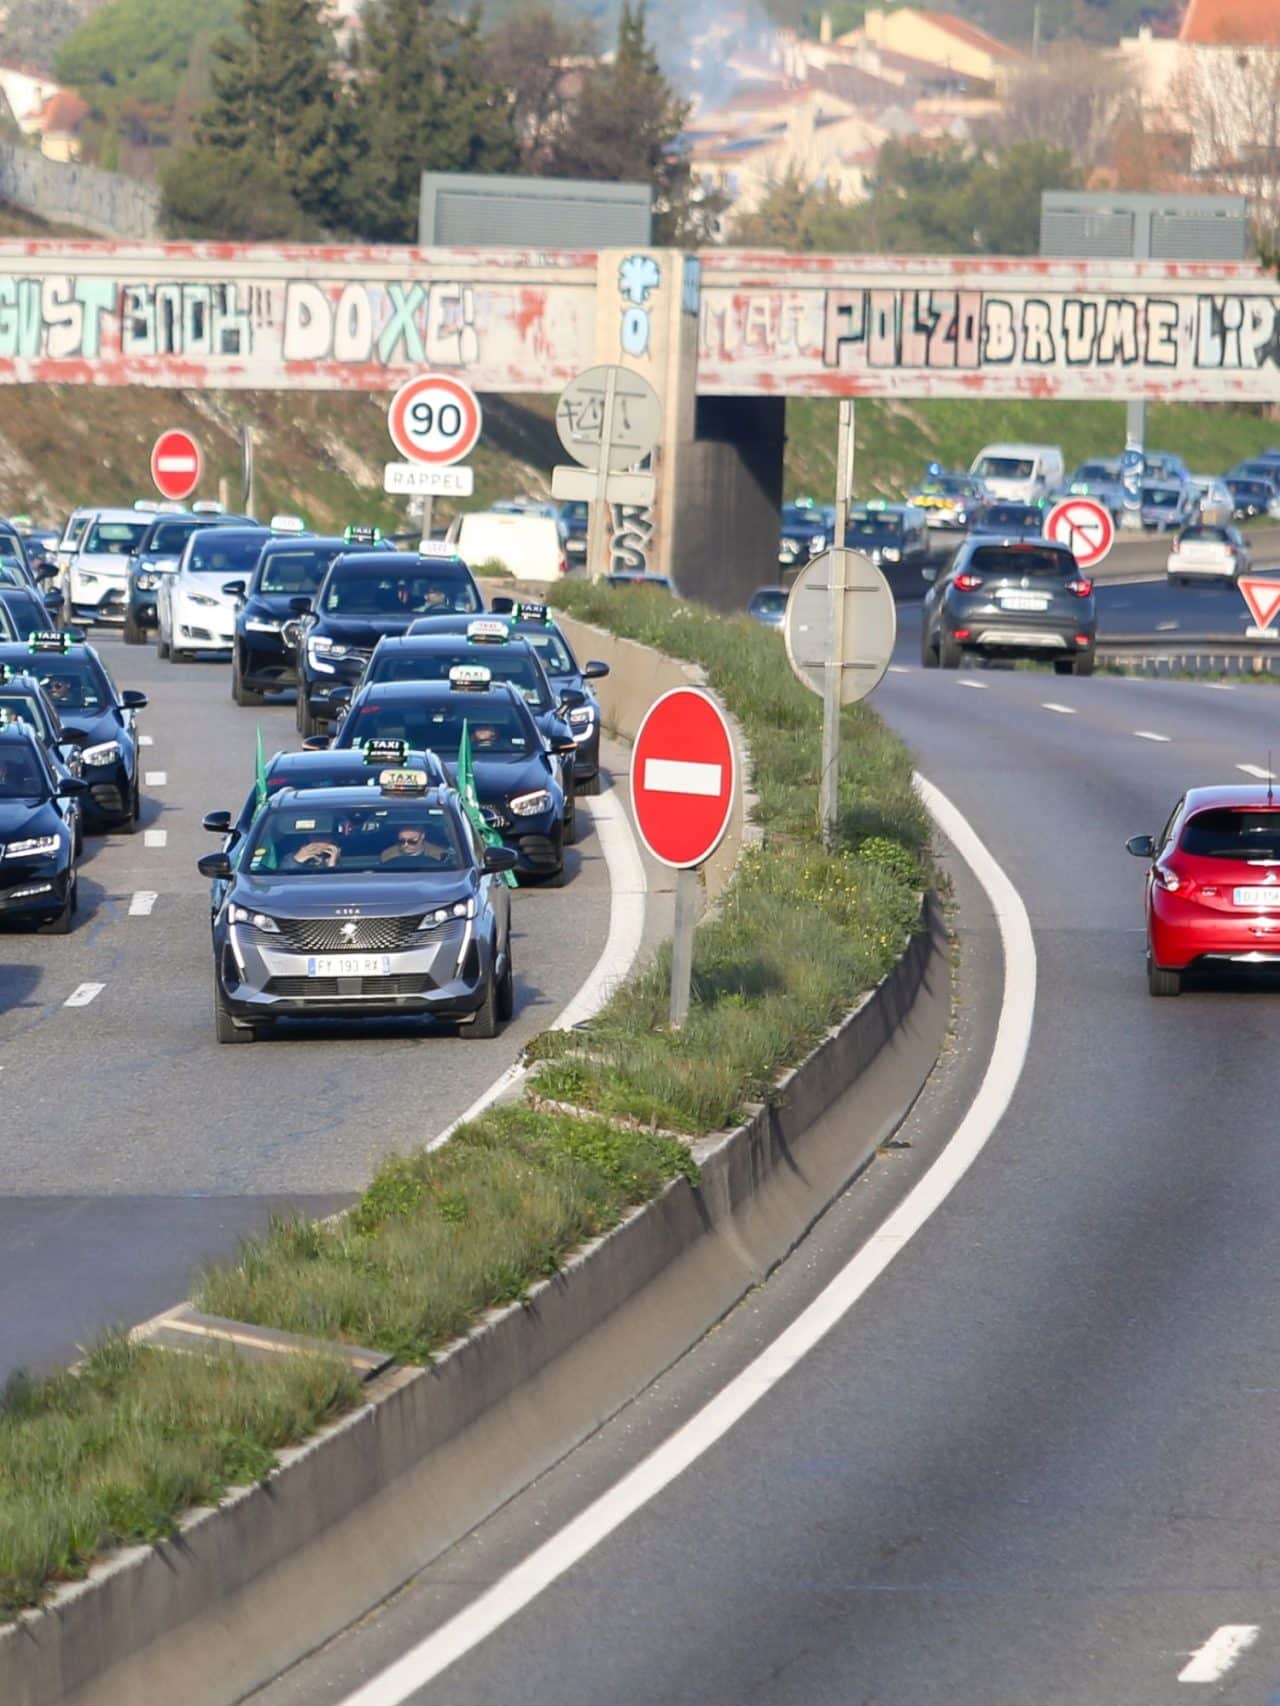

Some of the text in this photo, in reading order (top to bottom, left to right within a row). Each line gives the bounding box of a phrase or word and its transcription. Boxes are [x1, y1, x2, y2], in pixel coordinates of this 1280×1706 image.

[983, 297, 1179, 366] BRUME
[410, 402, 462, 438] 90
[392, 470, 465, 490] RAPPEL
[521, 604, 543, 612] TAXI
[36, 632, 61, 640] TAXI
[459, 670, 484, 678] TAXI
[372, 740, 400, 749] TAXI
[388, 773, 418, 782] TAXI
